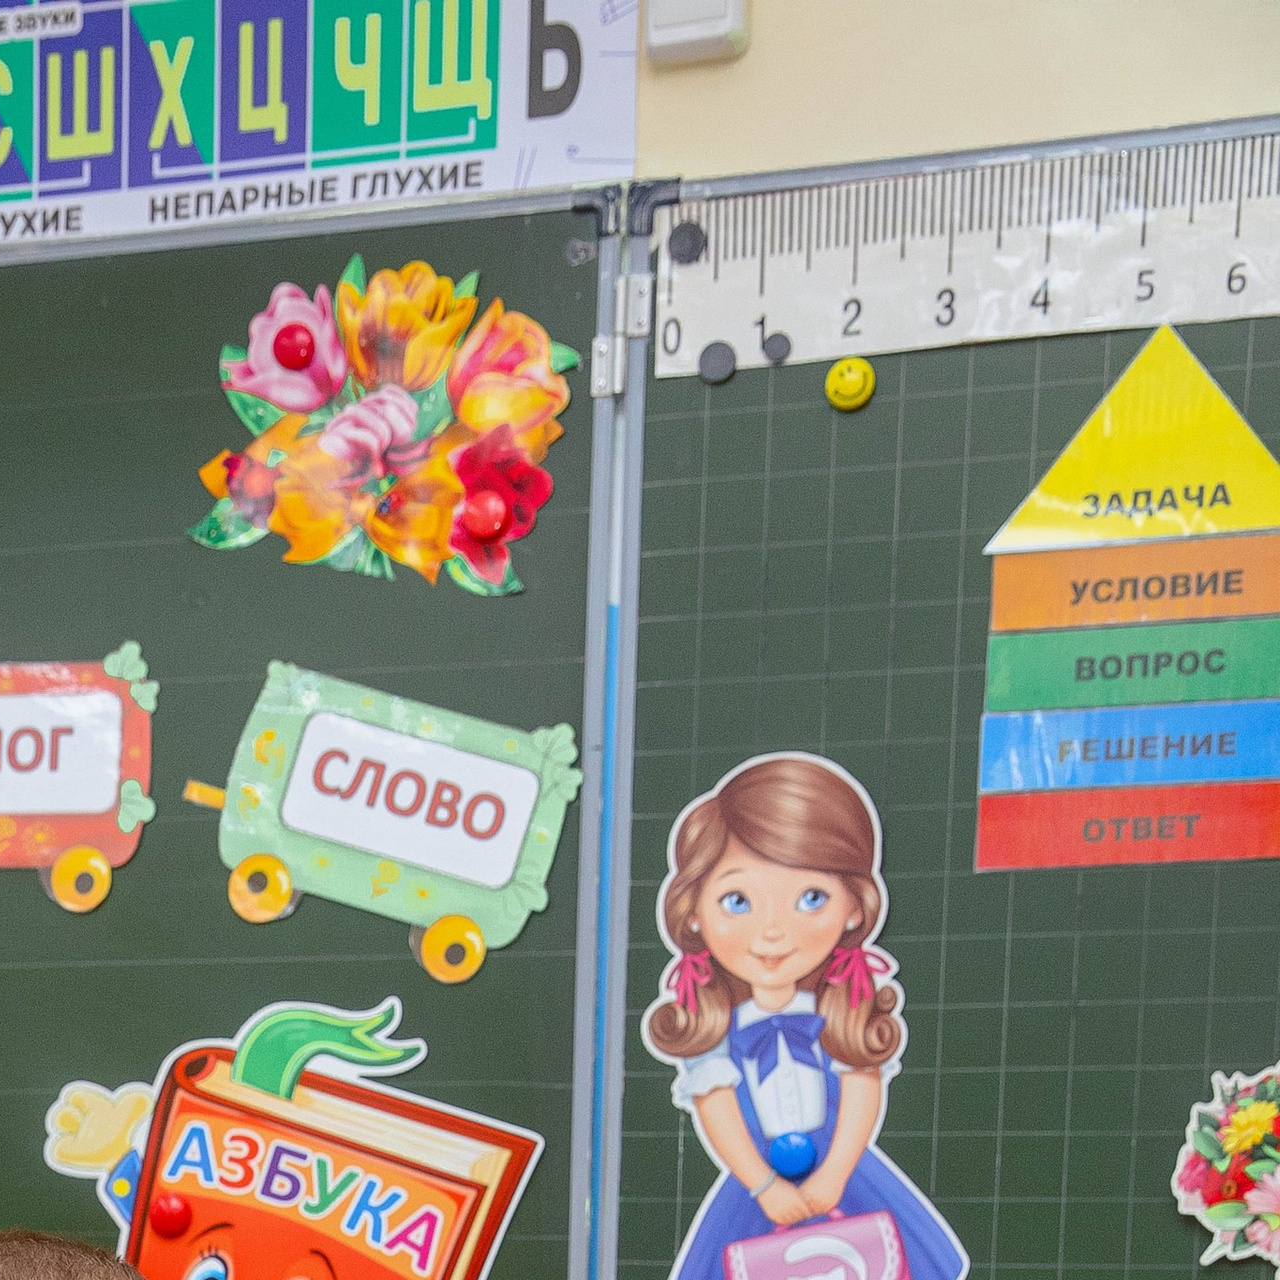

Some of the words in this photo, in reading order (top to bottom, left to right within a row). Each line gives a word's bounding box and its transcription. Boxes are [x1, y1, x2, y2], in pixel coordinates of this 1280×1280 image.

[16, 10, 76, 31] ЗВУКИ
[46, 46, 115, 161] Ш
[148, 35, 195, 150] Х
[238, 17, 288, 143] Ц
[334, 12, 383, 126] Ч
[412, 0, 494, 119] Щ
[148, 175, 339, 225] НЕПАРНЫЕ
[352, 160, 485, 200] ГЛУХИЕ
[662, 317, 682, 355] 0
[842, 298, 862, 336] 2
[935, 290, 956, 327] 3
[1030, 279, 1051, 316] 4
[1136, 270, 1155, 302] 5
[1227, 262, 1247, 295] 6
[1083, 481, 1232, 518] ЗАДАЧА
[1070, 569, 1244, 606] УСЛОВИЕ
[1074, 649, 1226, 682] ВОПРОС
[1057, 731, 1237, 763] РЕШЕНИЕ
[311, 748, 506, 842] СЛОВО
[1081, 813, 1202, 843] ОТВЕТ
[165, 1124, 446, 1273] АЗБУКА
